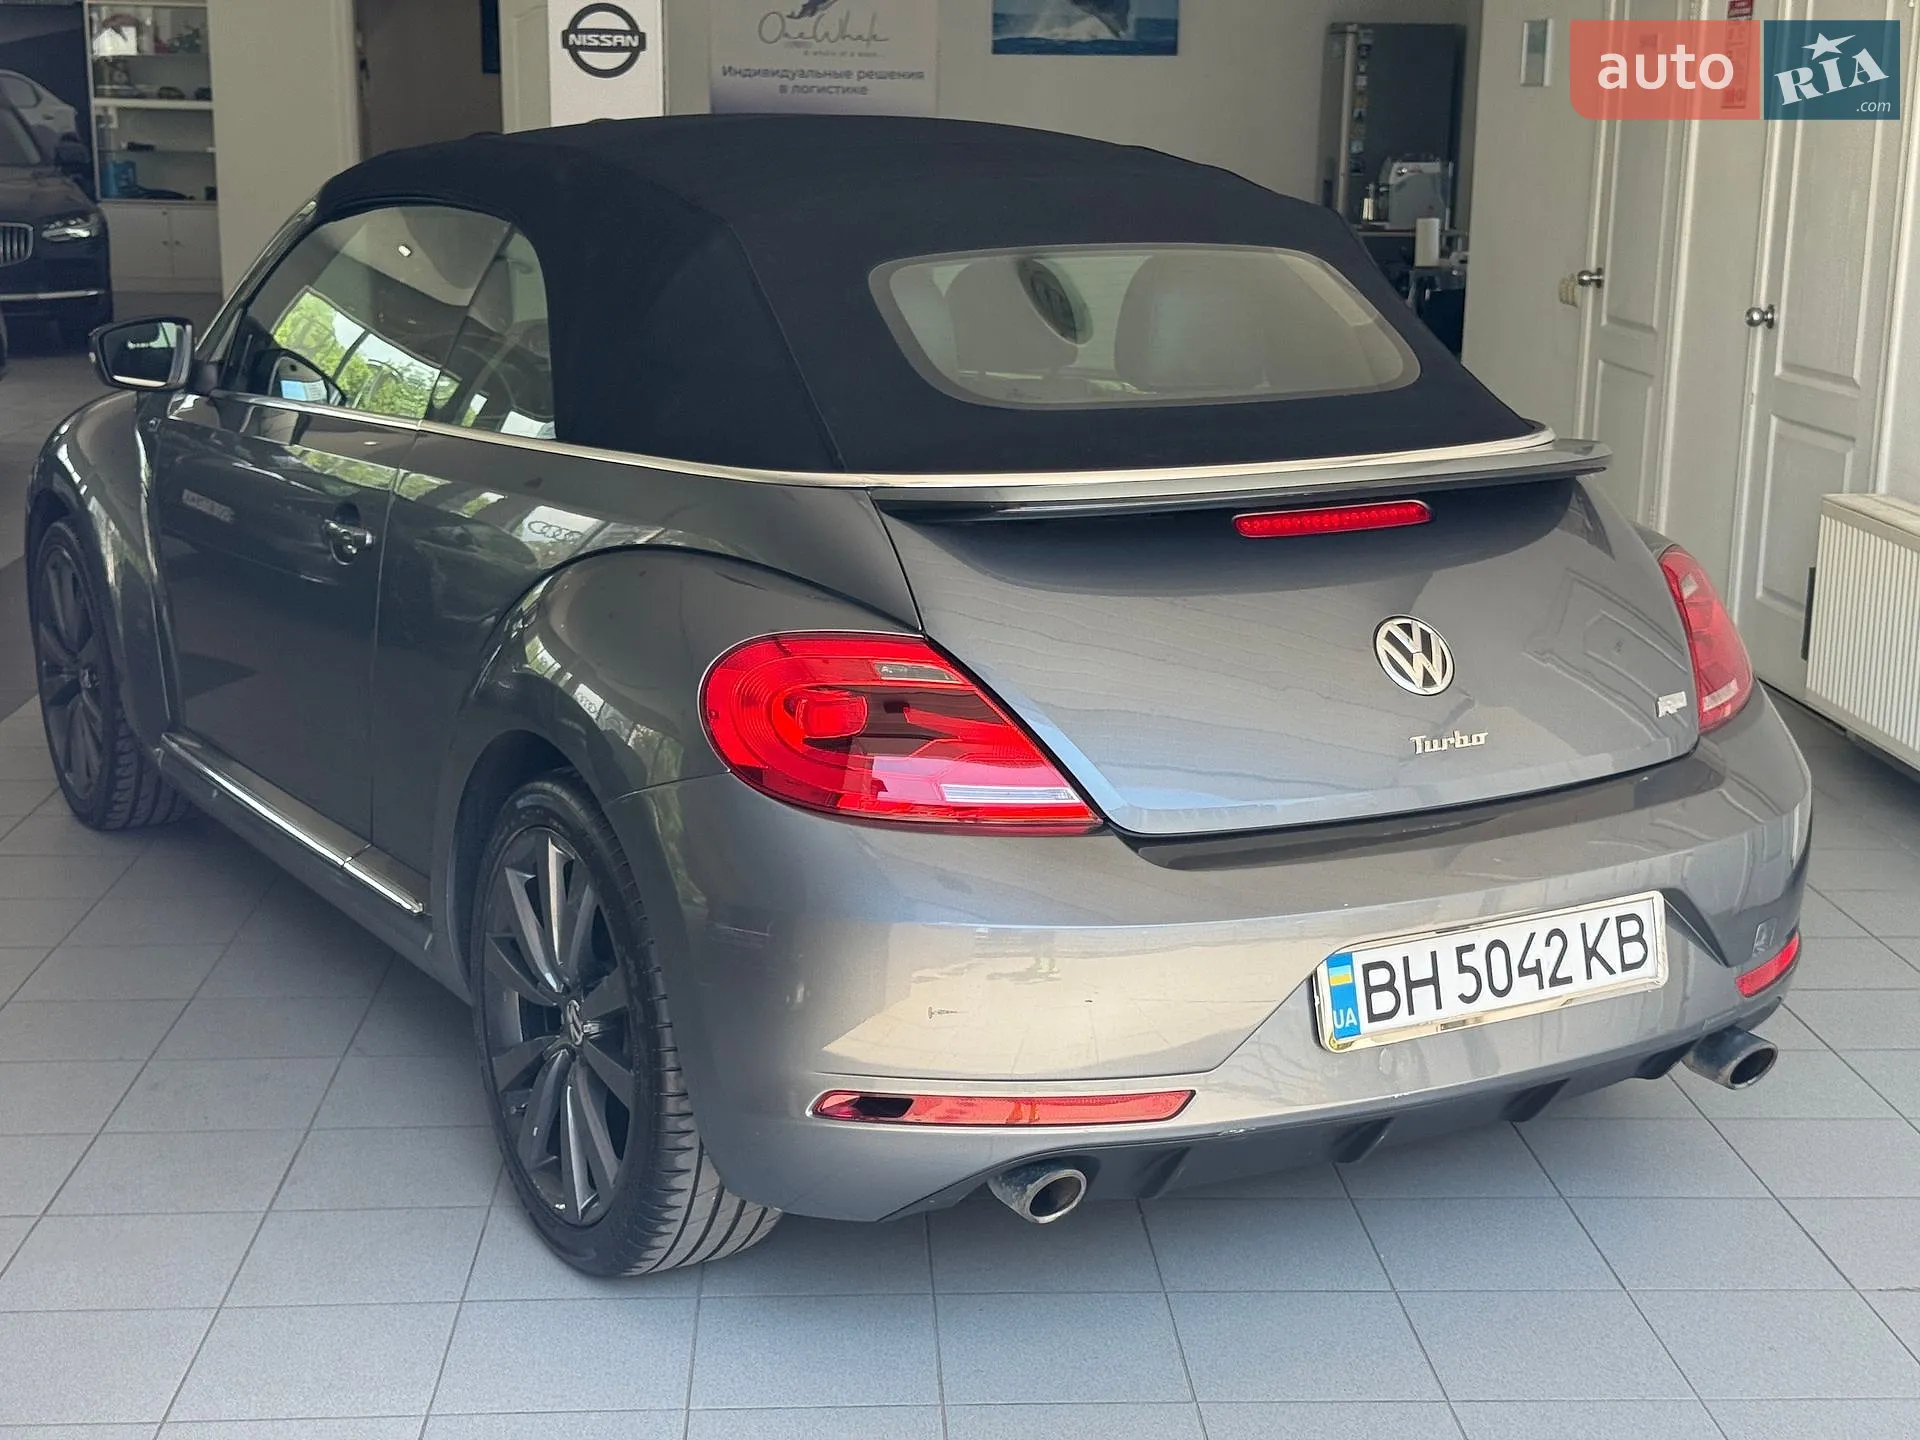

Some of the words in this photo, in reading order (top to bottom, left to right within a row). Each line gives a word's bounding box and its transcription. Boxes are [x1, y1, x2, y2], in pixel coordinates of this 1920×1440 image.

[568, 33, 640, 48] NISSAN
[721, 65, 851, 81] Индивидуальные
[856, 68, 925, 82] решения
[779, 84, 788, 94] в
[791, 84, 869, 96] логистике
[1409, 730, 1488, 755] Turbo
[1333, 1008, 1359, 1030] UA
[1362, 950, 1443, 1023] BH
[1455, 928, 1573, 1005] 5042
[1580, 913, 1649, 981] KB
